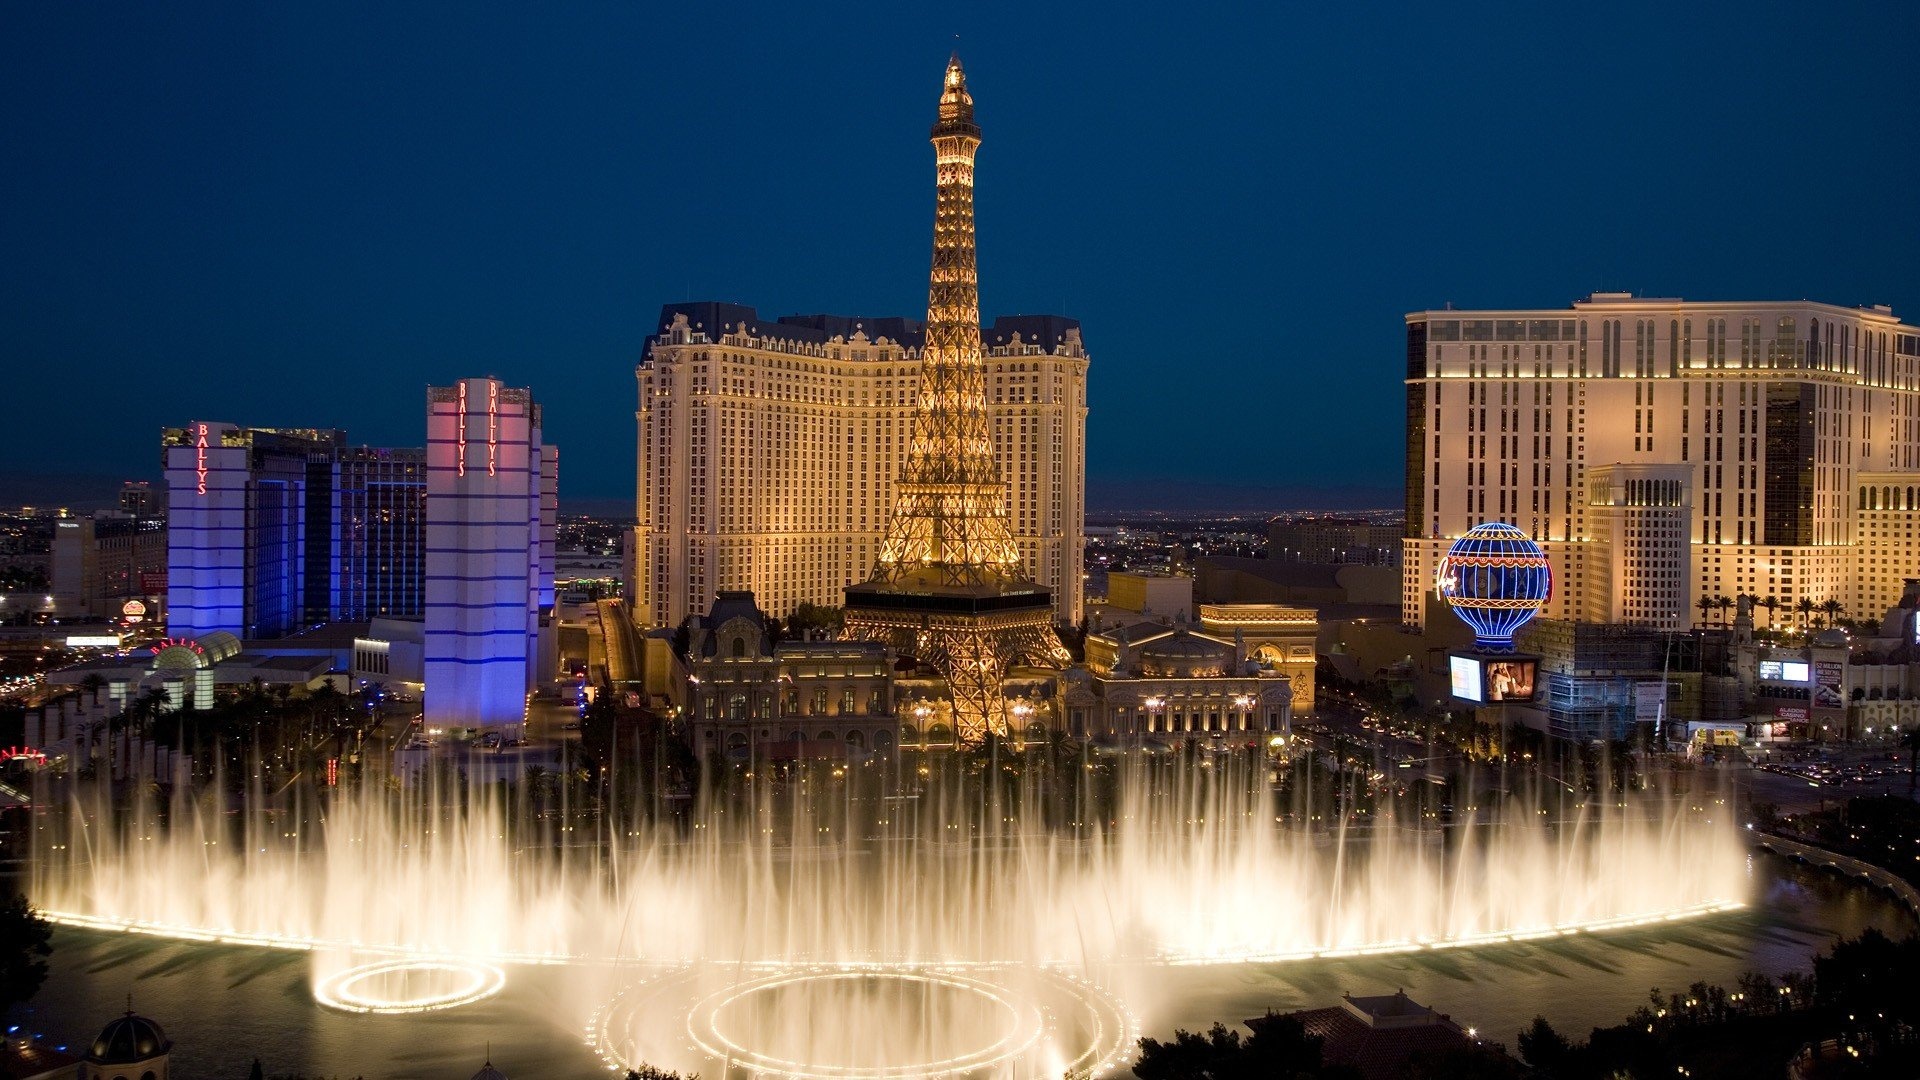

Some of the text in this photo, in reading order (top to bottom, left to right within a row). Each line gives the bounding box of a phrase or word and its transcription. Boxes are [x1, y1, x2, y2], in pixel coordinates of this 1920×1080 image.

[489, 381, 497, 476] BALLYS
[197, 424, 209, 495] BALLYS
[150, 637, 204, 655] BALLYS
[0, 745, 48, 766] ALLYS
